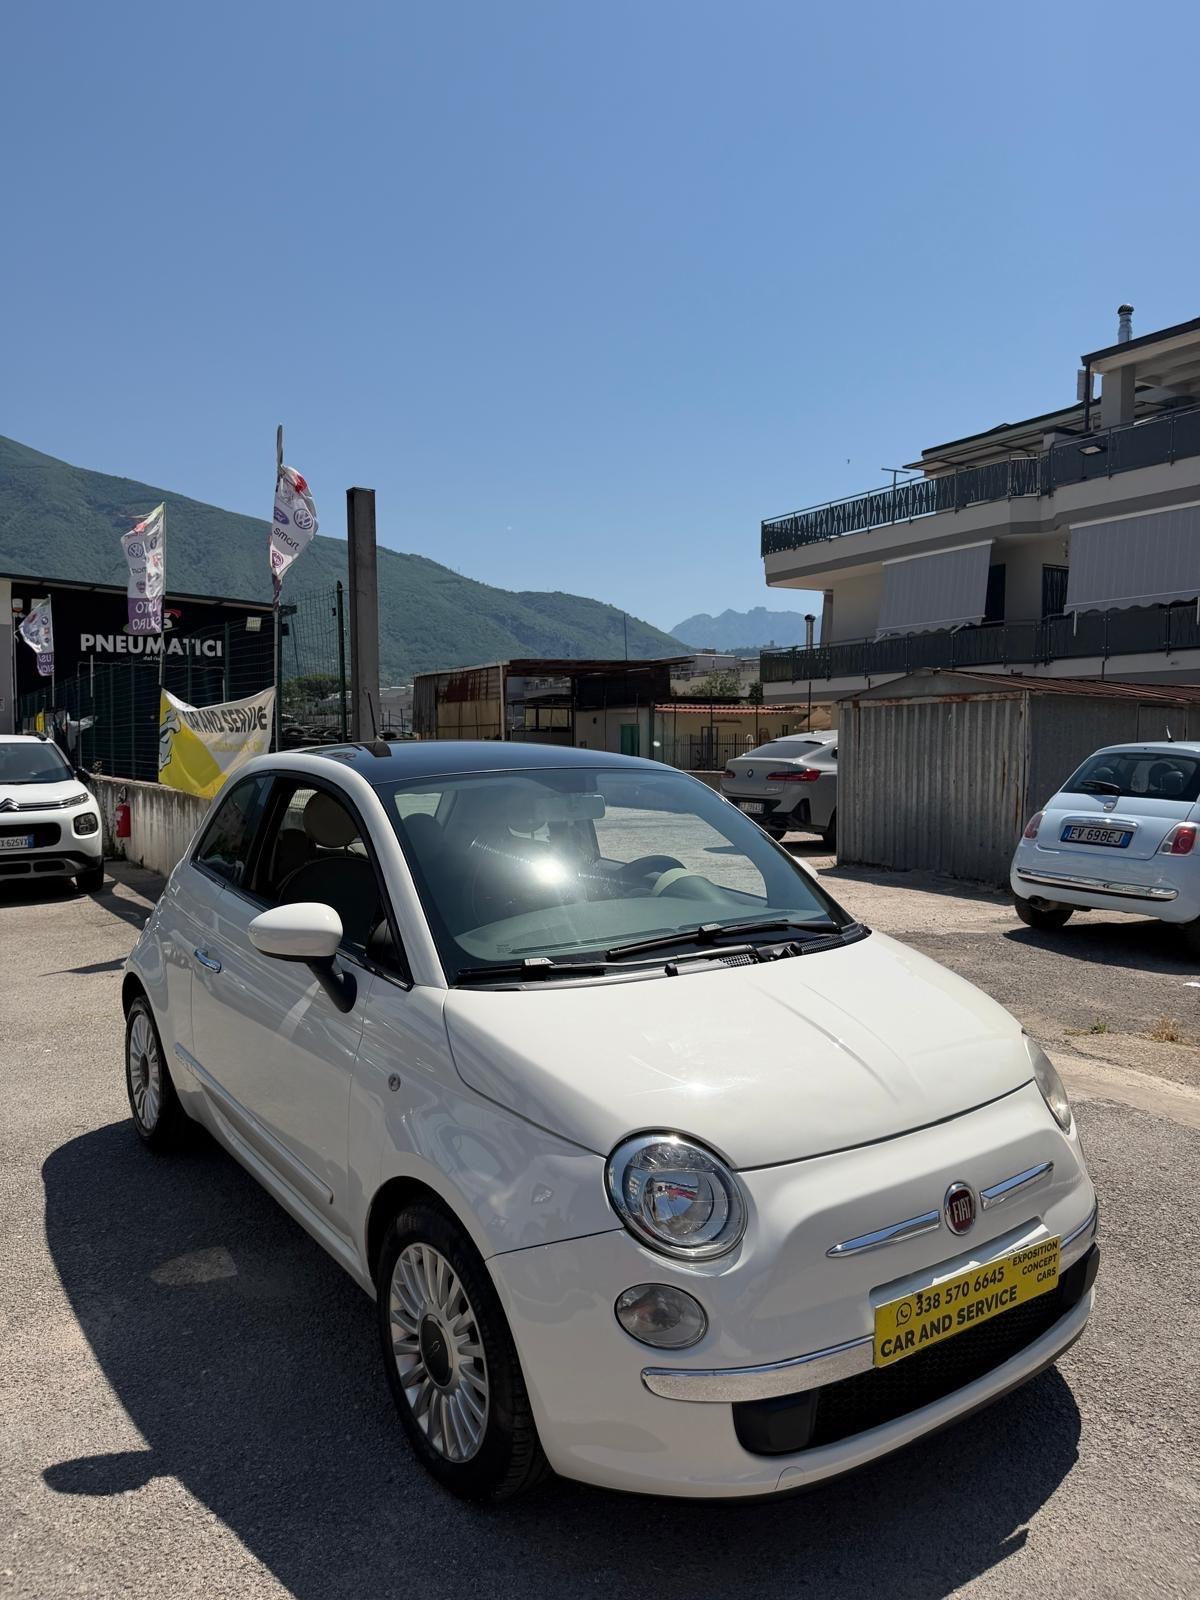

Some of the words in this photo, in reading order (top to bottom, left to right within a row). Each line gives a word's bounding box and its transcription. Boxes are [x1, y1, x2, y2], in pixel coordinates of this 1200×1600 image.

[273, 527, 300, 551] smart
[80, 633, 222, 657] PNEUMATICI
[198, 710, 224, 733] AND
[1070, 827, 1084, 839] EV
[1086, 829, 1122, 843] 698EJ
[952, 1196, 971, 1223] FIAT
[1012, 1240, 1058, 1267] EXPOSITION
[1022, 1253, 1058, 1276] CONCEPT
[1036, 1267, 1057, 1283] CARS
[915, 1292, 941, 1317] 338
[945, 1281, 970, 1305] 570
[973, 1267, 1005, 1293] 6645
[880, 1330, 915, 1358] CAR
[918, 1315, 953, 1343] AND
[956, 1285, 1018, 1326] SERVICE
